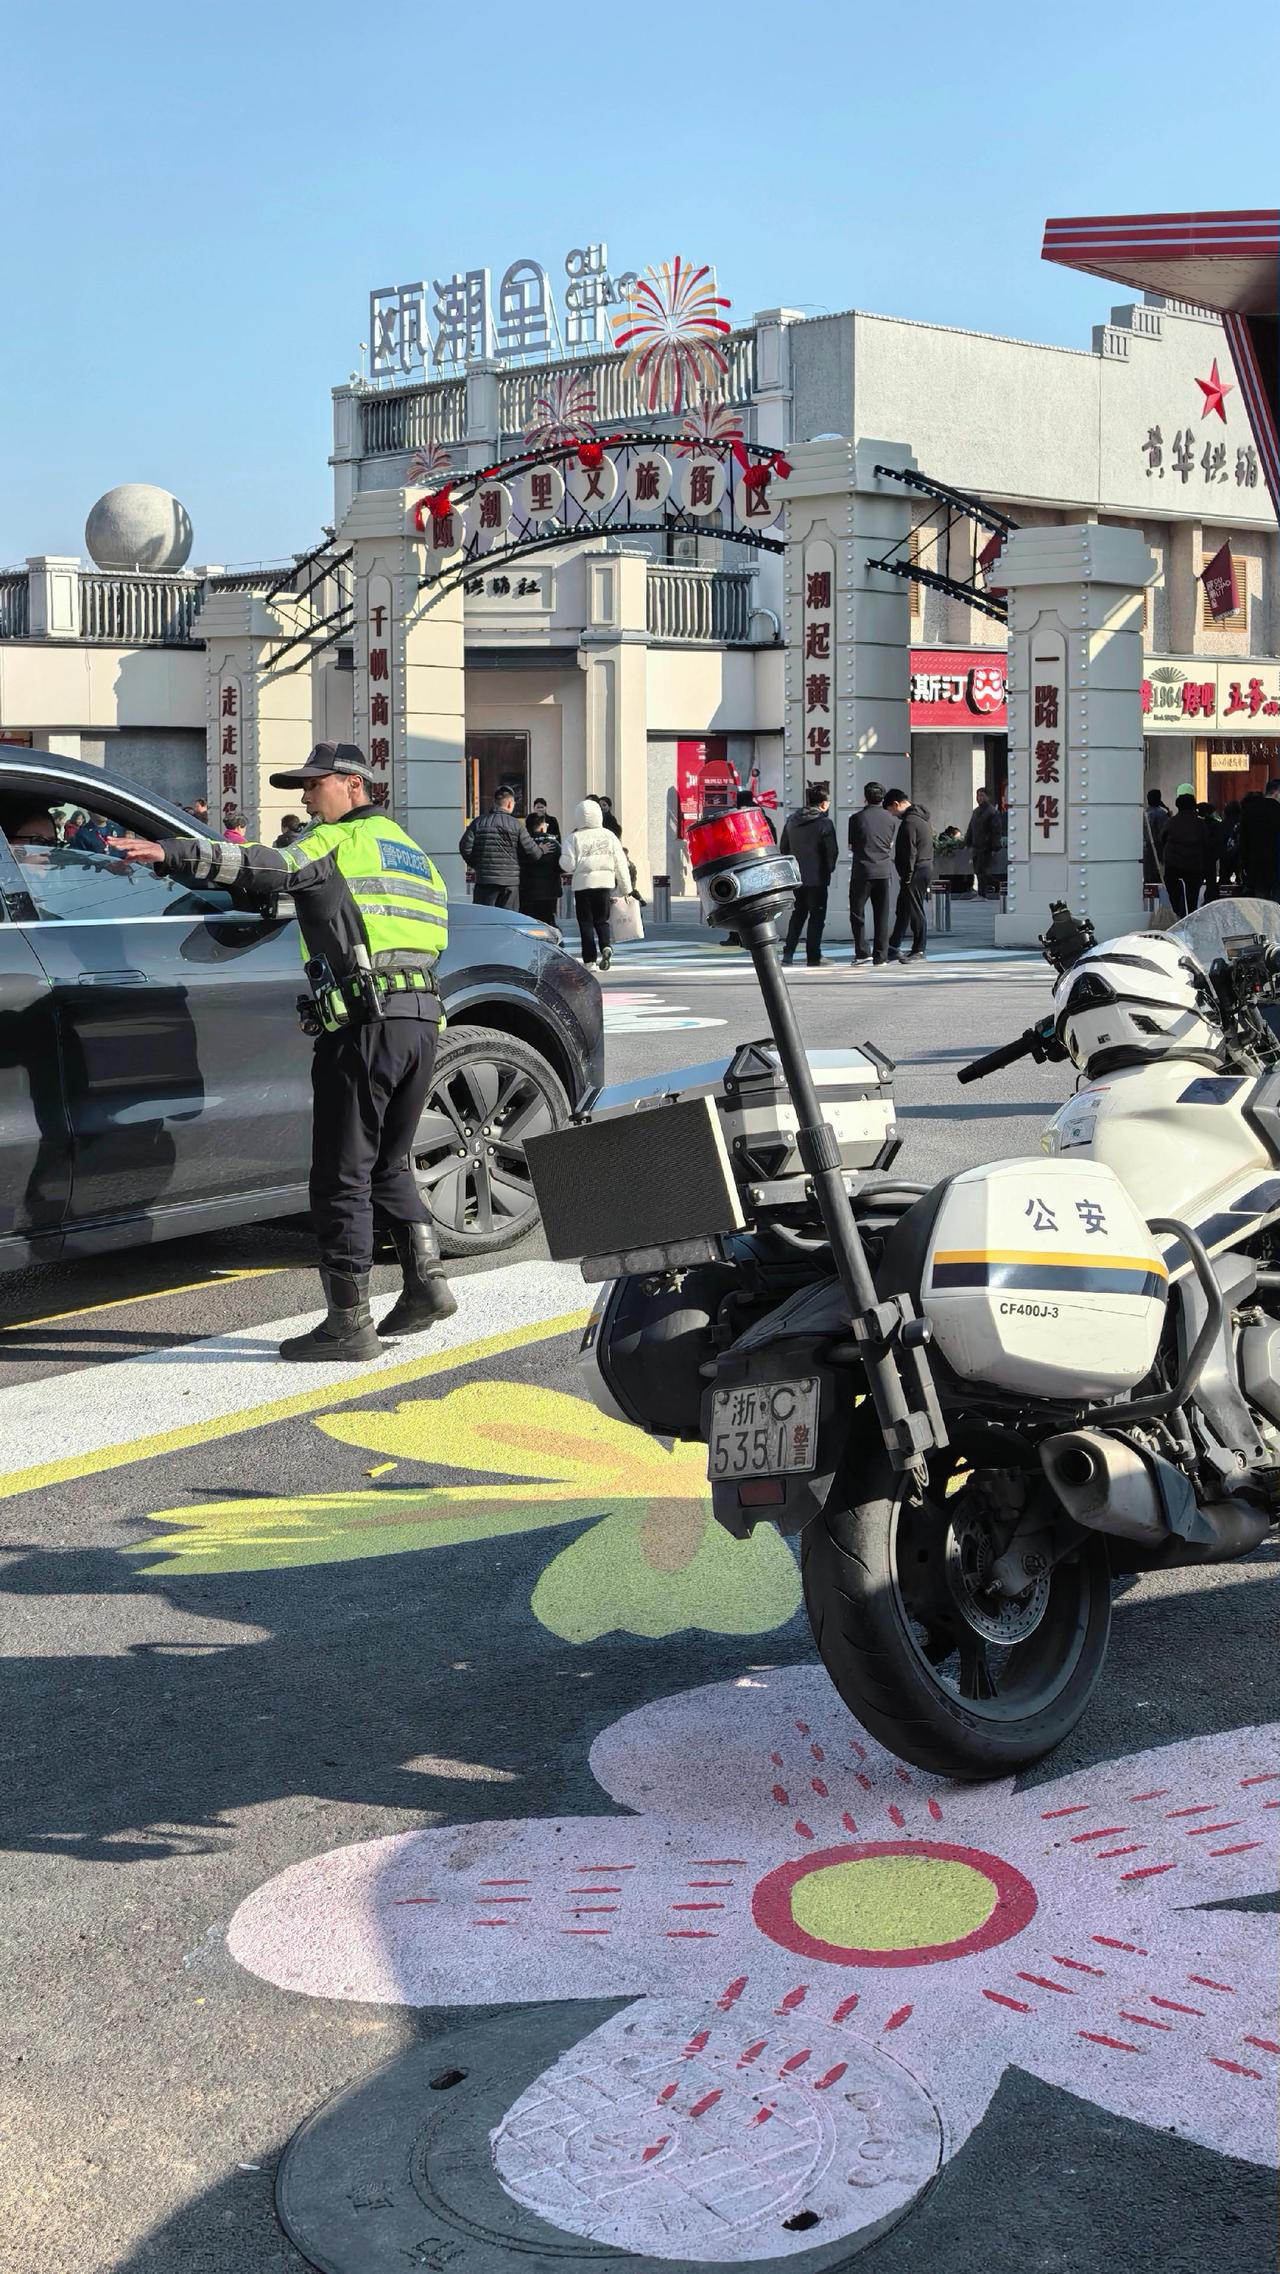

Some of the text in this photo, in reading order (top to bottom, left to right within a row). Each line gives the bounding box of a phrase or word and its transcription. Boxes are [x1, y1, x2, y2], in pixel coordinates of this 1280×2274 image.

[565, 243, 608, 279] OU
[370, 258, 556, 378] 瓯潮里
[1141, 425, 1267, 488] 黄华供销
[910, 674, 968, 703] 斯汀
[1035, 656, 1060, 839] 一路繁华
[1025, 1198, 1108, 1235] 公安
[1000, 1302, 1059, 1319] CF400J-3
